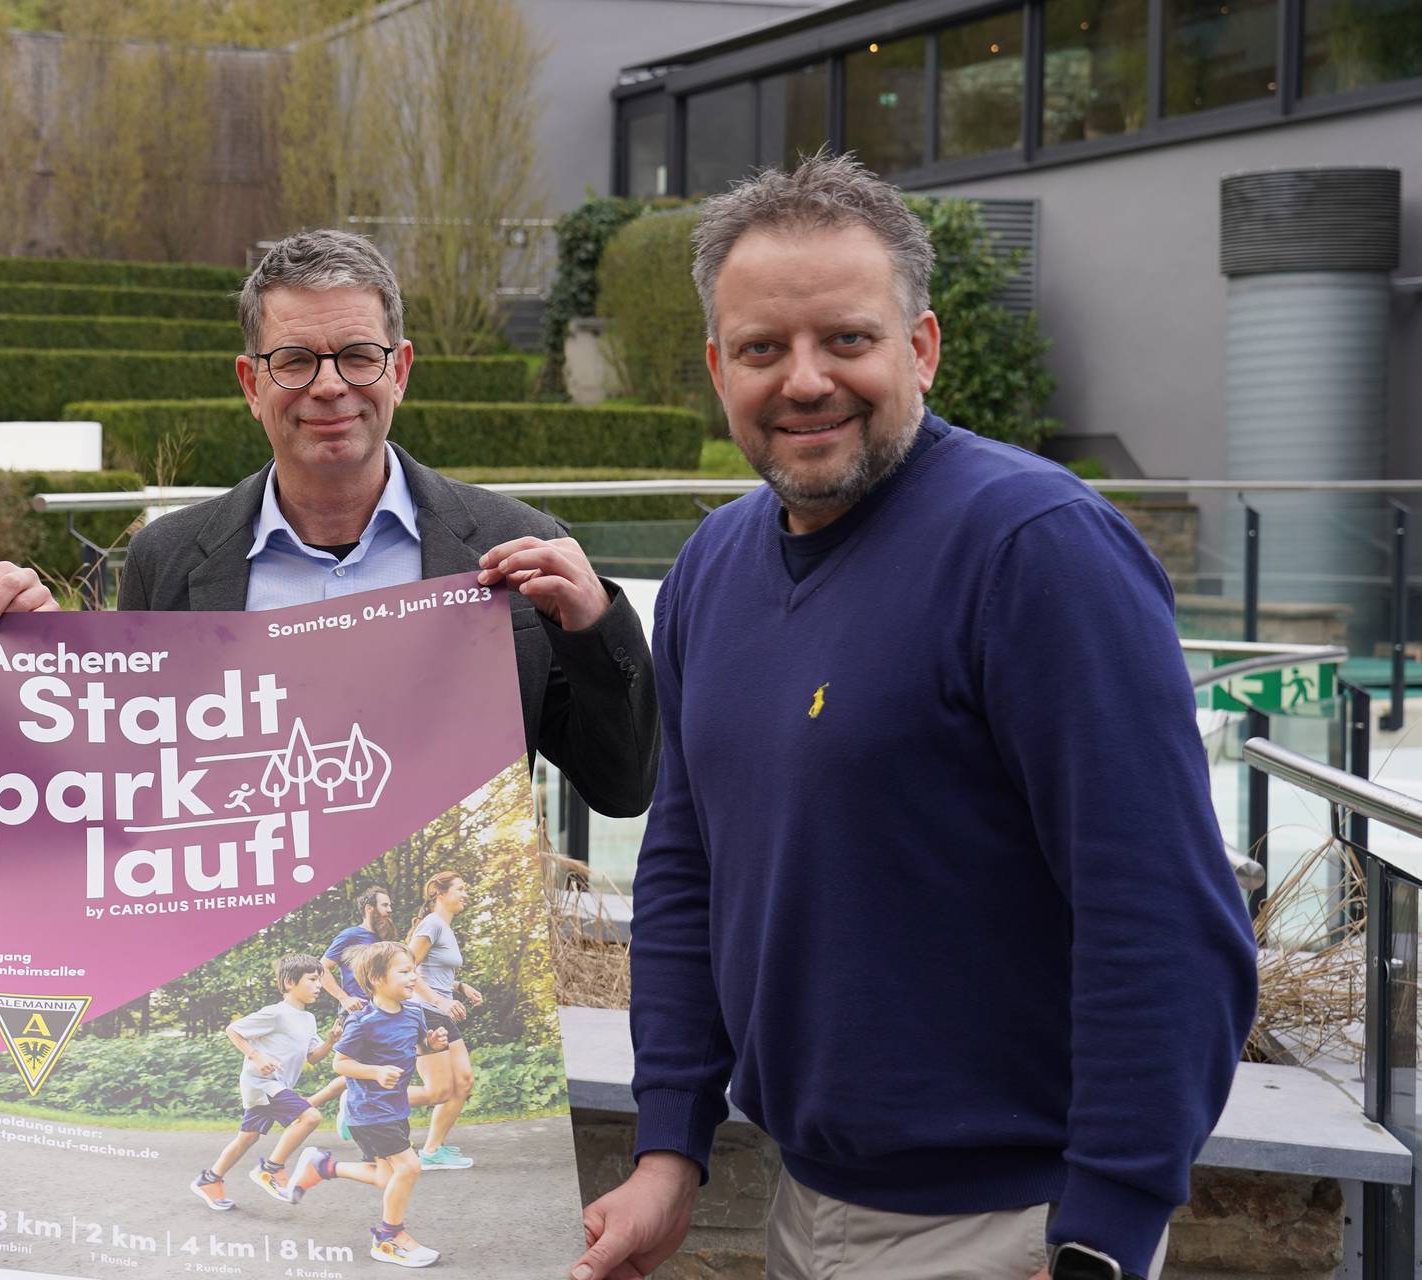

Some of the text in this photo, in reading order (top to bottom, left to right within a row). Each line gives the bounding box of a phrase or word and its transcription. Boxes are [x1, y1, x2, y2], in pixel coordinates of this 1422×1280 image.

[267, 586, 492, 638] Sonntag, 04. Juni 2023
[18, 669, 288, 745] Stadt
[86, 810, 315, 899] lauf!
[86, 892, 276, 919] by CAROLUS THERMEN
[22, 1013, 51, 1037] A
[57, 1123, 103, 1139] unter:
[17, 1211, 62, 1239] km
[85, 1222, 103, 1244] 2
[112, 1225, 157, 1252] km
[179, 1236, 200, 1256] 4
[209, 1234, 255, 1258] km
[280, 1239, 299, 1260] 8
[307, 1238, 354, 1262] km
[89, 1251, 139, 1268] 1 Runde
[184, 1262, 242, 1275] 2 Runden
[284, 1268, 343, 1280] 4 Runden
